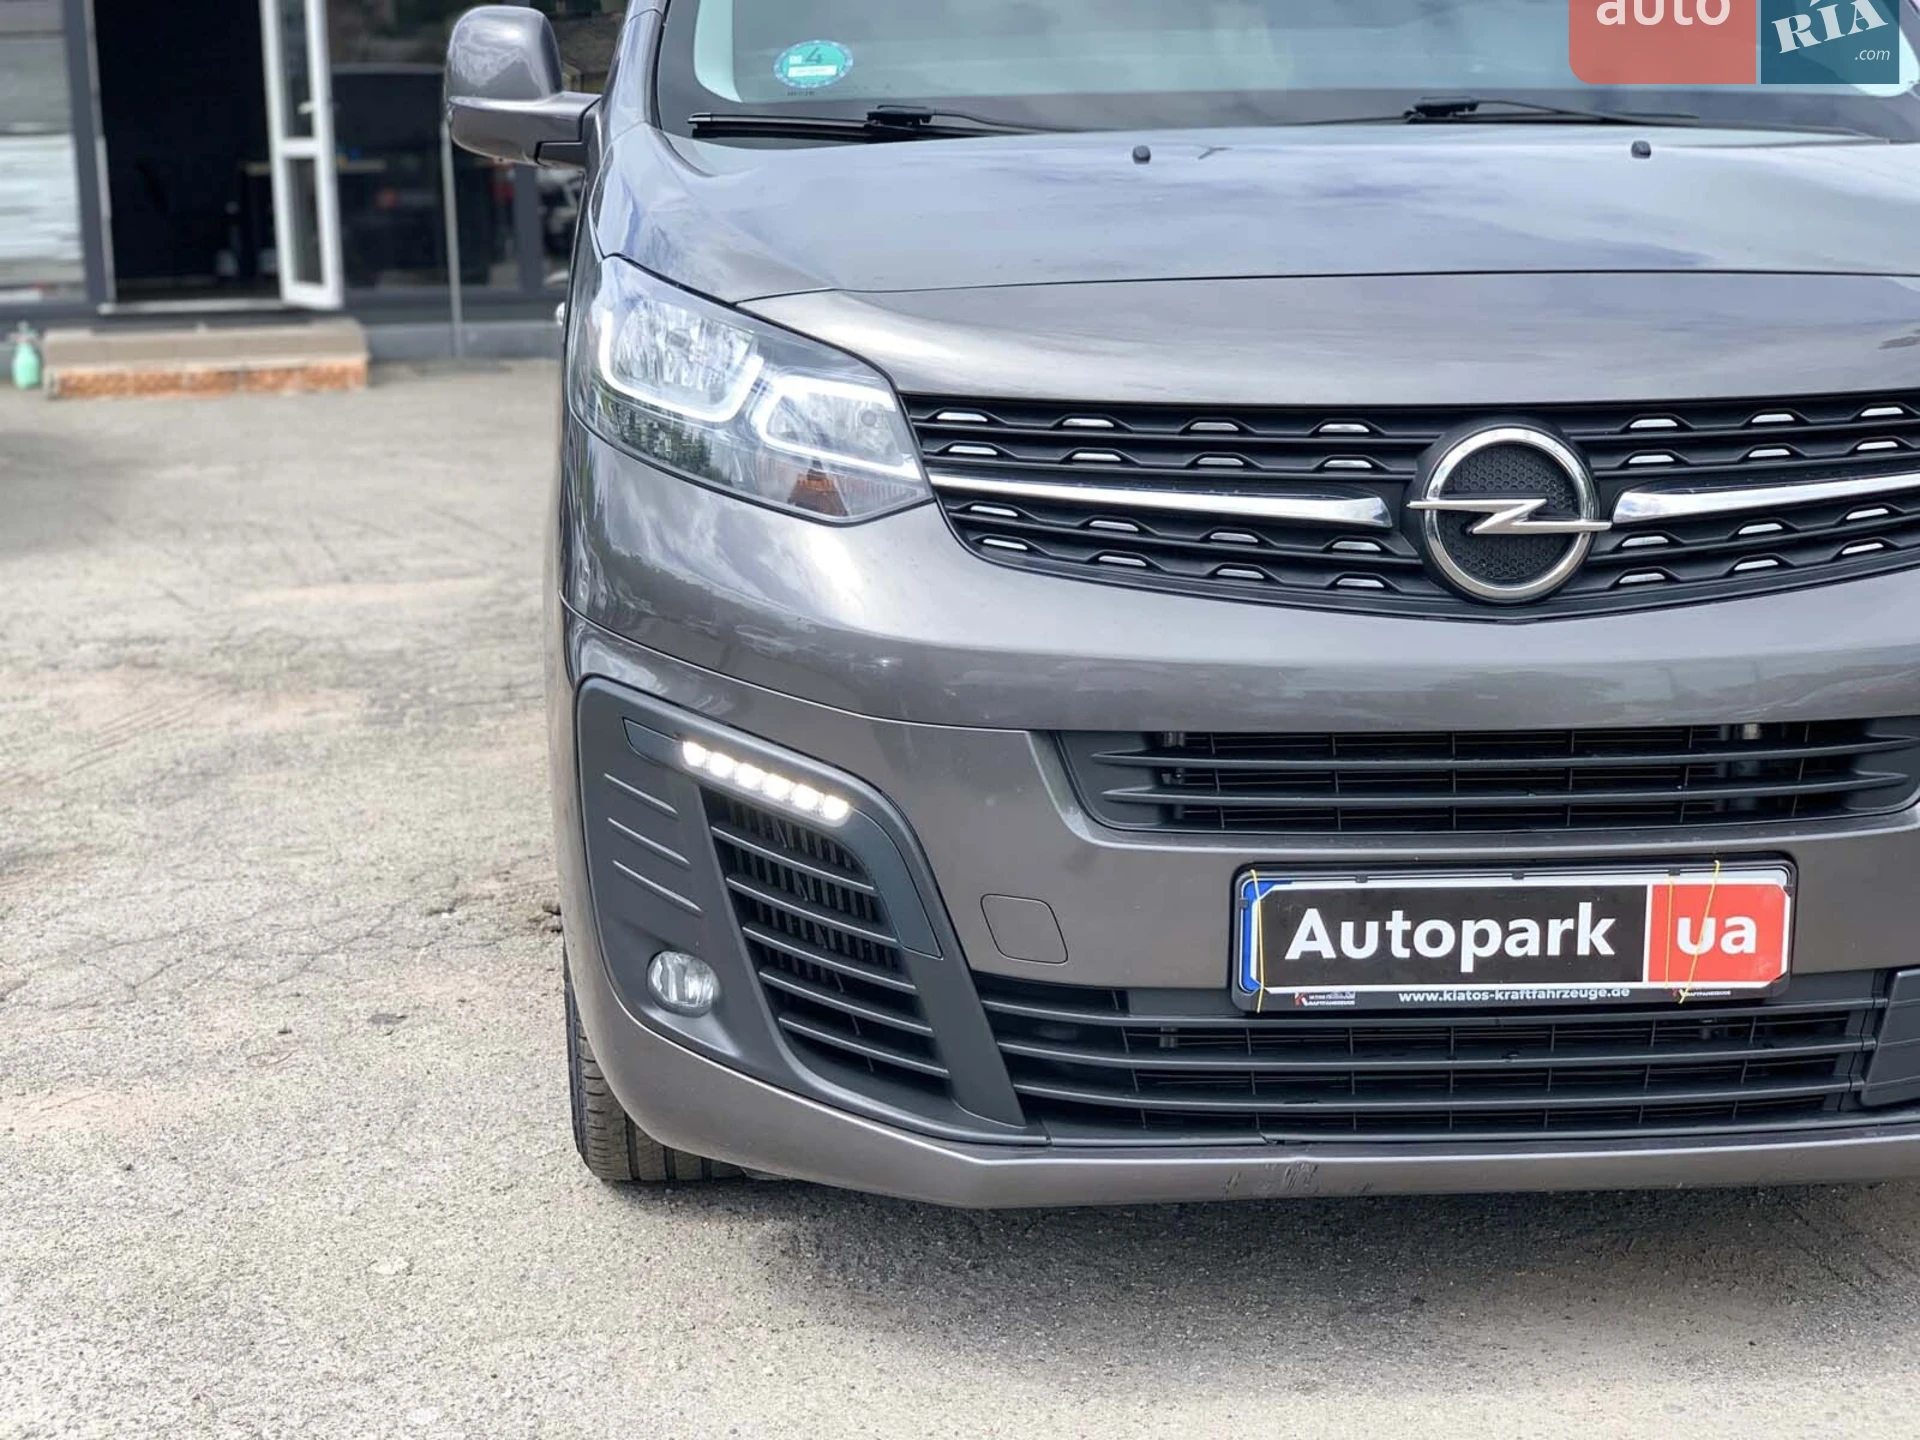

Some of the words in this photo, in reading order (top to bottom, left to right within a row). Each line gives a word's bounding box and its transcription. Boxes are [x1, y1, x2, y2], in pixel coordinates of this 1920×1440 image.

[804, 47, 824, 63] 4
[1284, 901, 1617, 973] Autopark
[1676, 914, 1757, 955] ua
